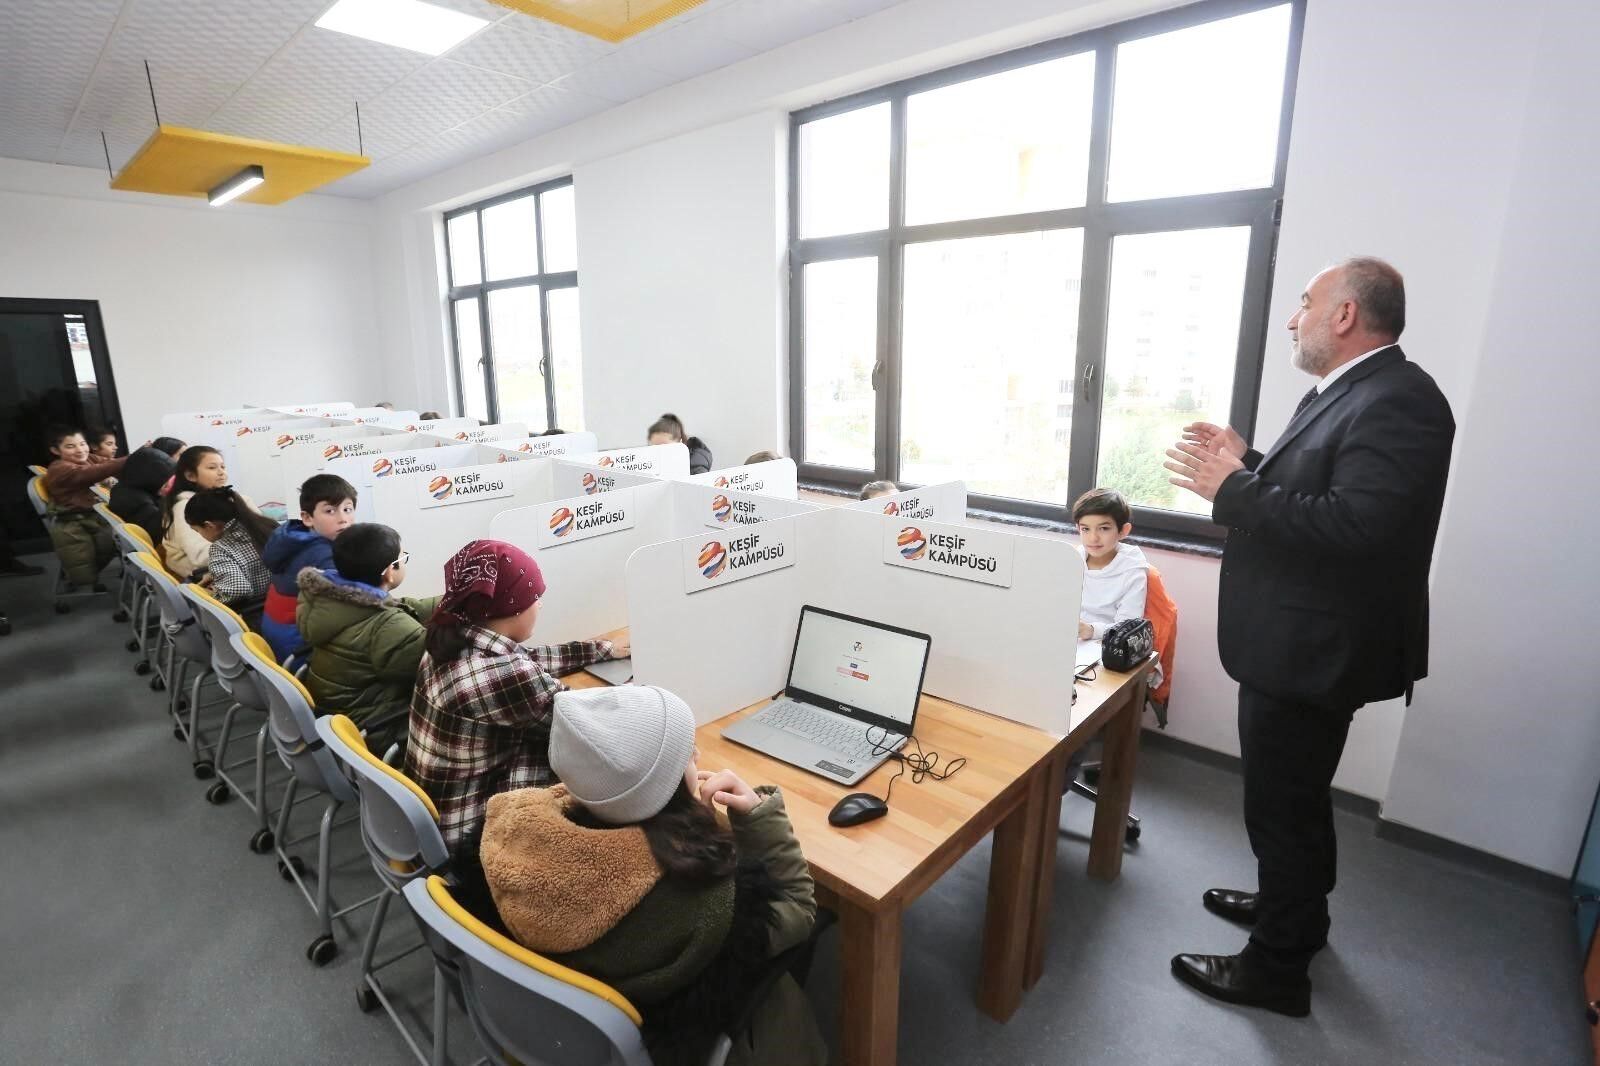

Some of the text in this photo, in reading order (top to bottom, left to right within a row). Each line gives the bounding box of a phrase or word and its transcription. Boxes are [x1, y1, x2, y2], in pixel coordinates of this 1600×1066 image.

[343, 442, 364, 453] KEŞİF
[394, 455, 417, 467] KEŞİF
[615, 454, 635, 464] KEŞİF
[395, 463, 437, 475] KAMPÜSÜ
[454, 472, 481, 485] KEŞİF
[730, 472, 749, 485] KEŞİF
[455, 480, 504, 496] KAMPÜSÜ
[576, 501, 604, 518] KEŞİF
[732, 500, 756, 514] KEŞİF
[900, 497, 920, 512] KEŞİF
[576, 509, 625, 531] KAMPÜSÜ
[728, 533, 760, 554] KEŞİF
[929, 533, 966, 552] KEŞİF
[729, 543, 785, 570] KAMPÜSÜ
[928, 549, 997, 573] KAMPÜSÜ
